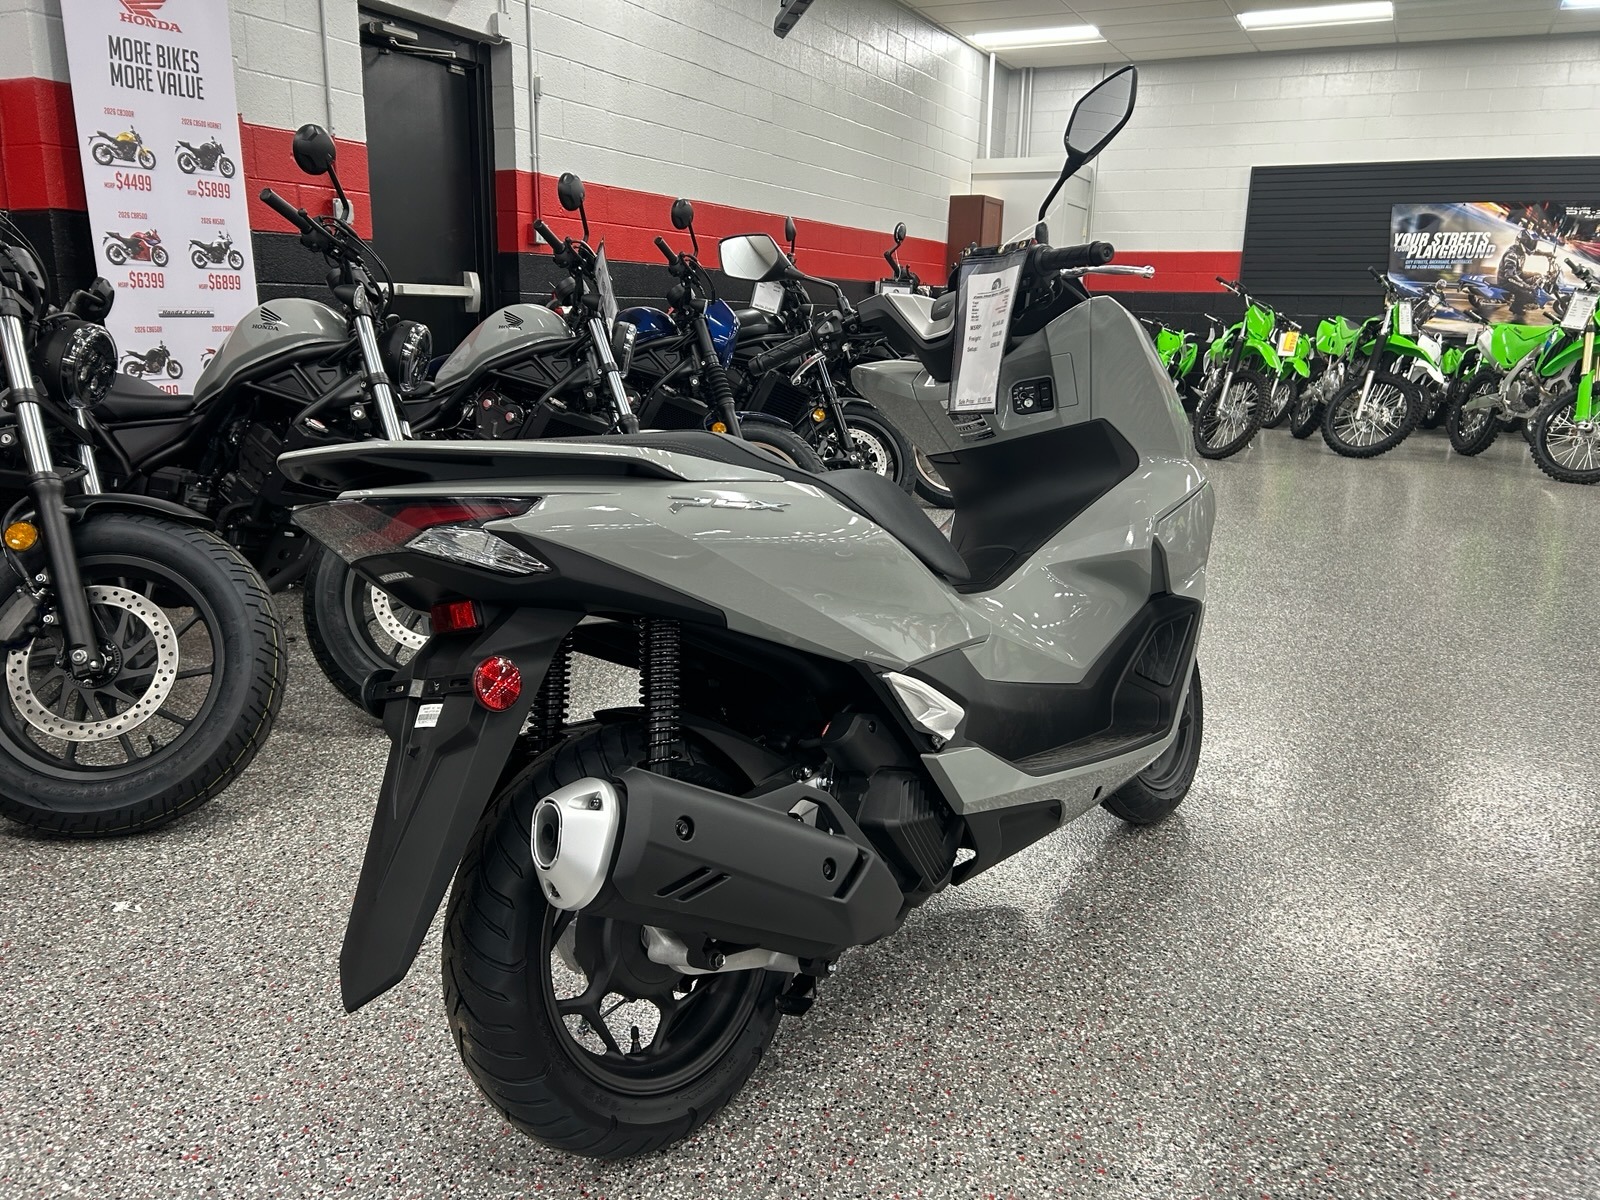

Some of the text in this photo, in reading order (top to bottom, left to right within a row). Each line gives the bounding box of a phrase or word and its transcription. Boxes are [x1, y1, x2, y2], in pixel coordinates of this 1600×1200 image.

[119, 12, 183, 33] HONDA
[108, 34, 200, 74] MORE BIKES
[109, 61, 205, 100] MORE VALUE
[103, 107, 116, 116] 2026
[181, 118, 193, 126] 2026
[115, 171, 152, 192] $4499
[197, 179, 231, 199] $5899
[118, 211, 130, 219] 2026
[201, 217, 212, 225] 2026
[1395, 231, 1492, 247] YOUR STREETS
[1406, 244, 1496, 259] PLAYGROUND
[128, 270, 165, 290] $6399
[208, 273, 241, 291] $6899
[379, 571, 414, 583] HONDA
